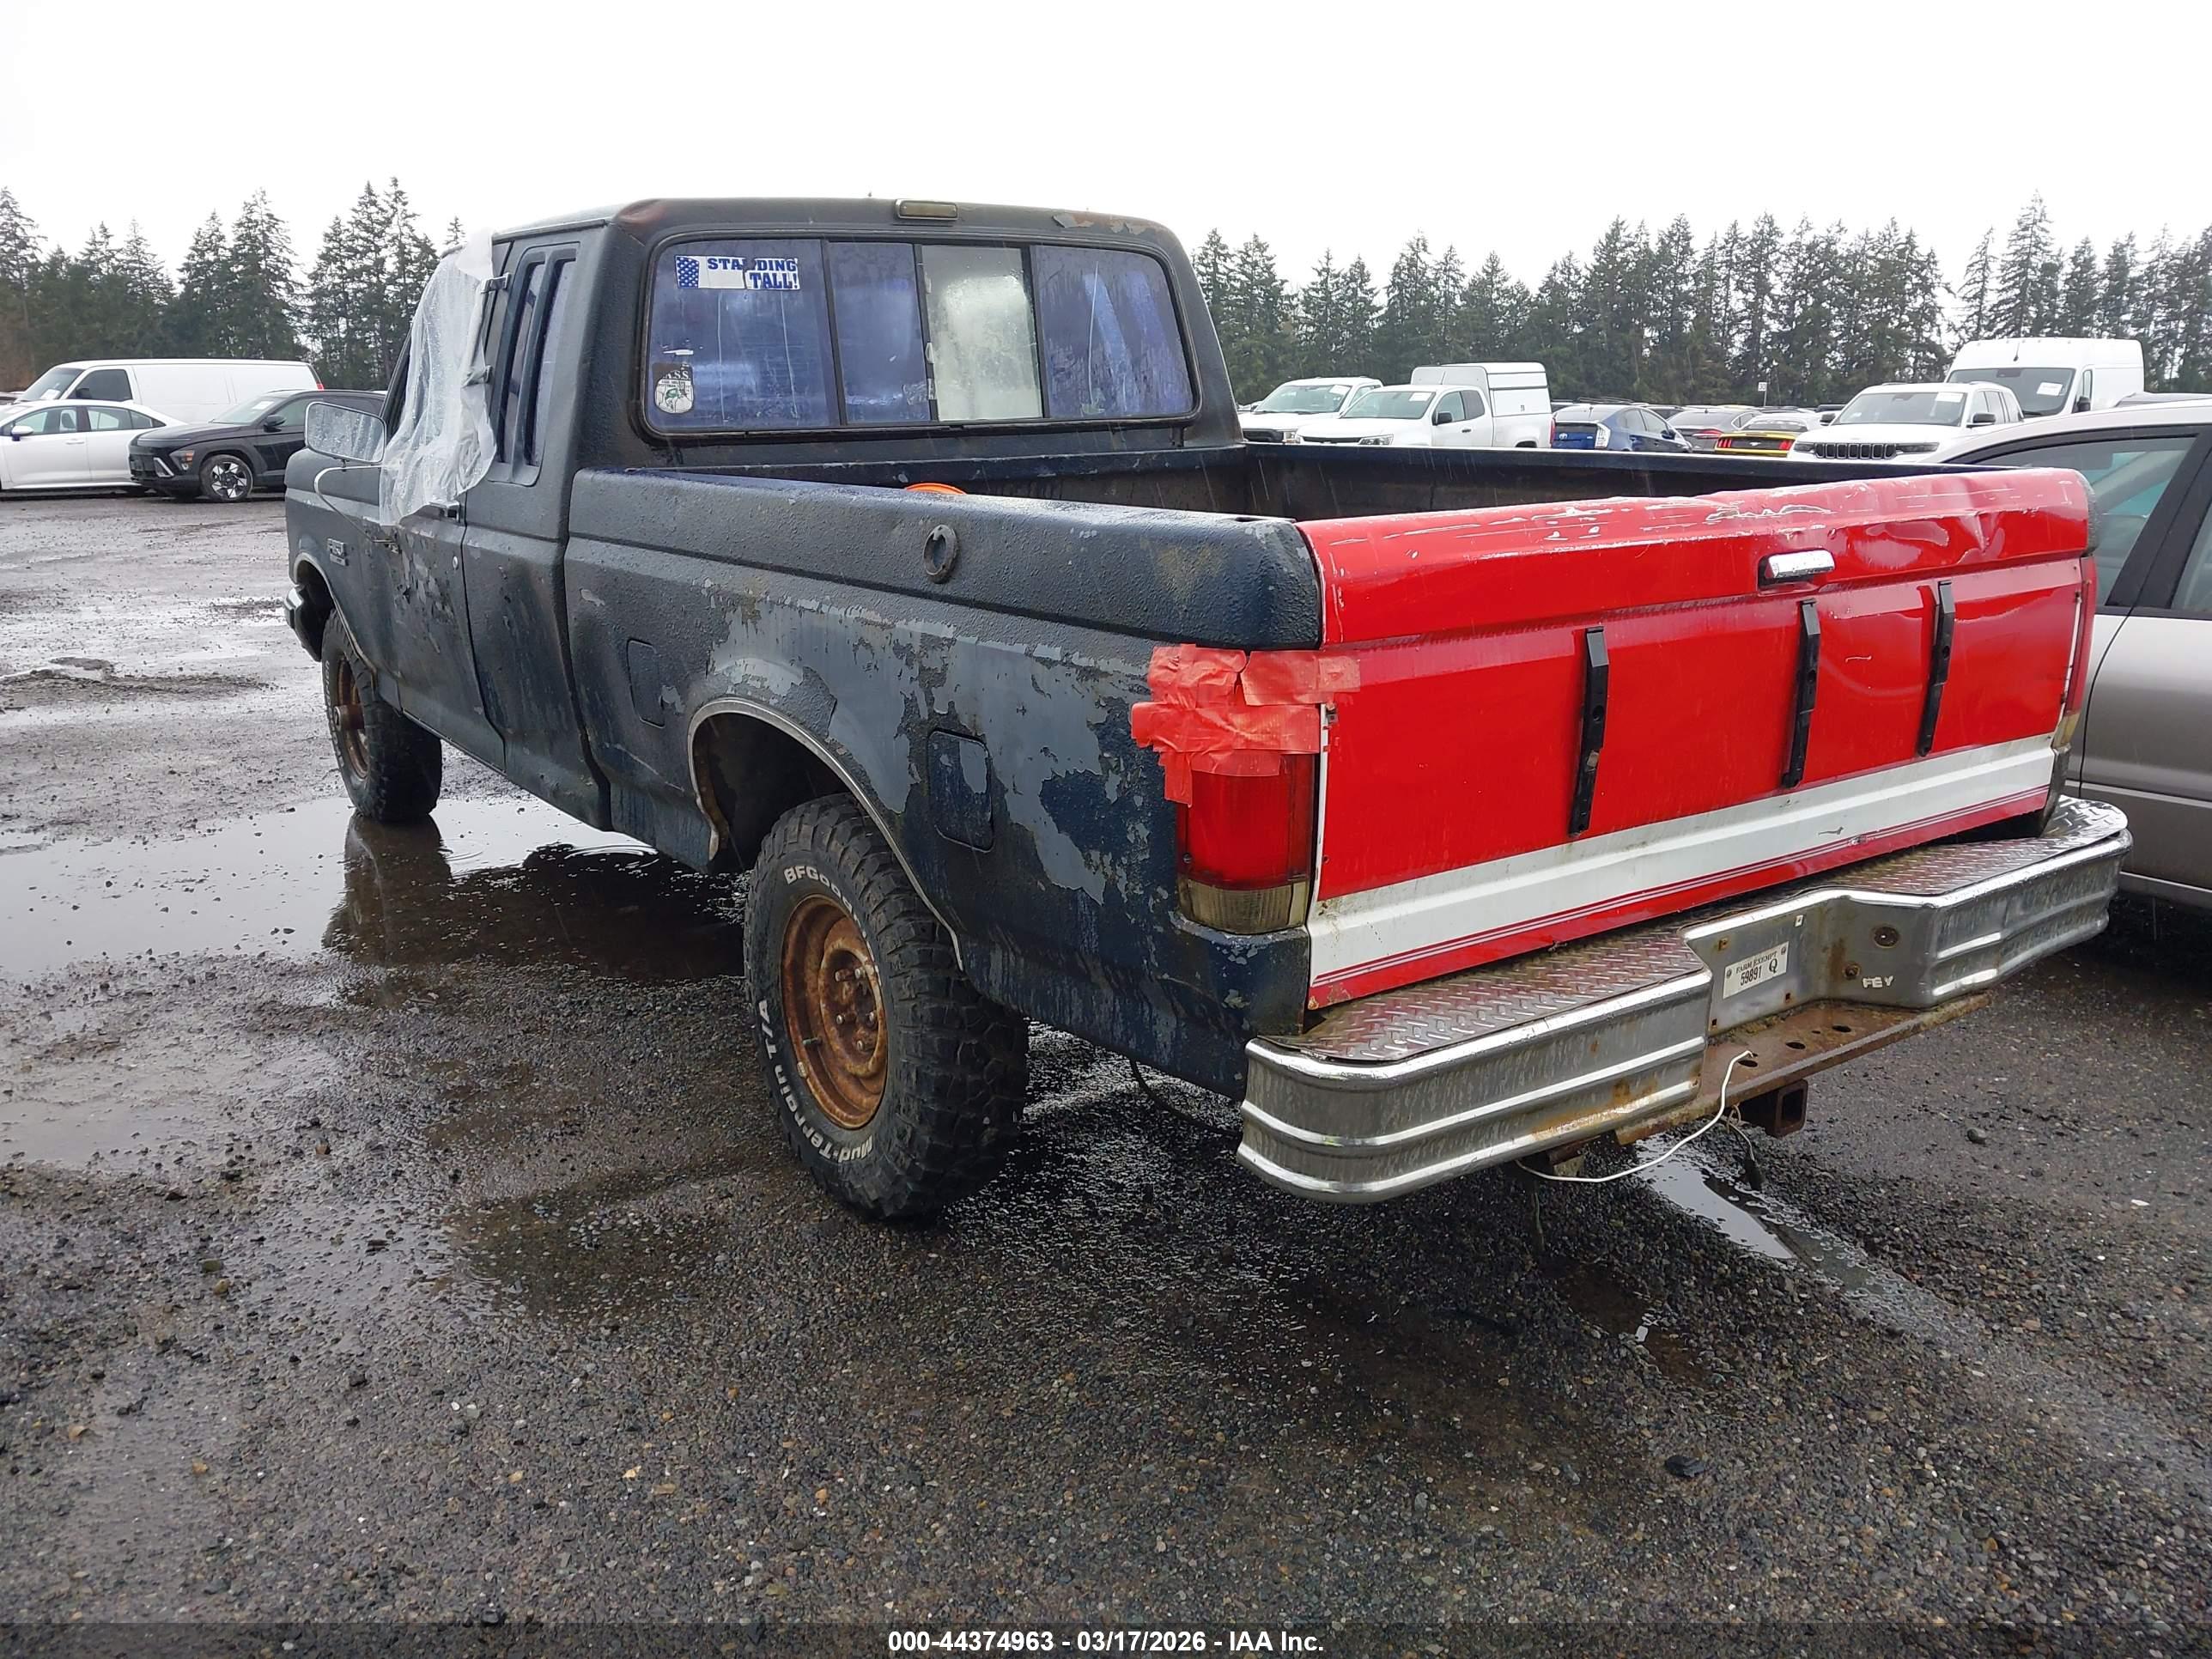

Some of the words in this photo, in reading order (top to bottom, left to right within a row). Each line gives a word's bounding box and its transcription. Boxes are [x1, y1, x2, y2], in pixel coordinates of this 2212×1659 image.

[707, 258, 797, 271] STADING
[750, 272, 799, 289] TALL!
[1735, 961, 1753, 975] FARM
[1753, 950, 1778, 967] EXEMPT
[1740, 964, 1762, 987] 59891
[1769, 957, 1778, 975] Q
[1862, 975, 1894, 988] FEY
[758, 999, 777, 1060] T/A
